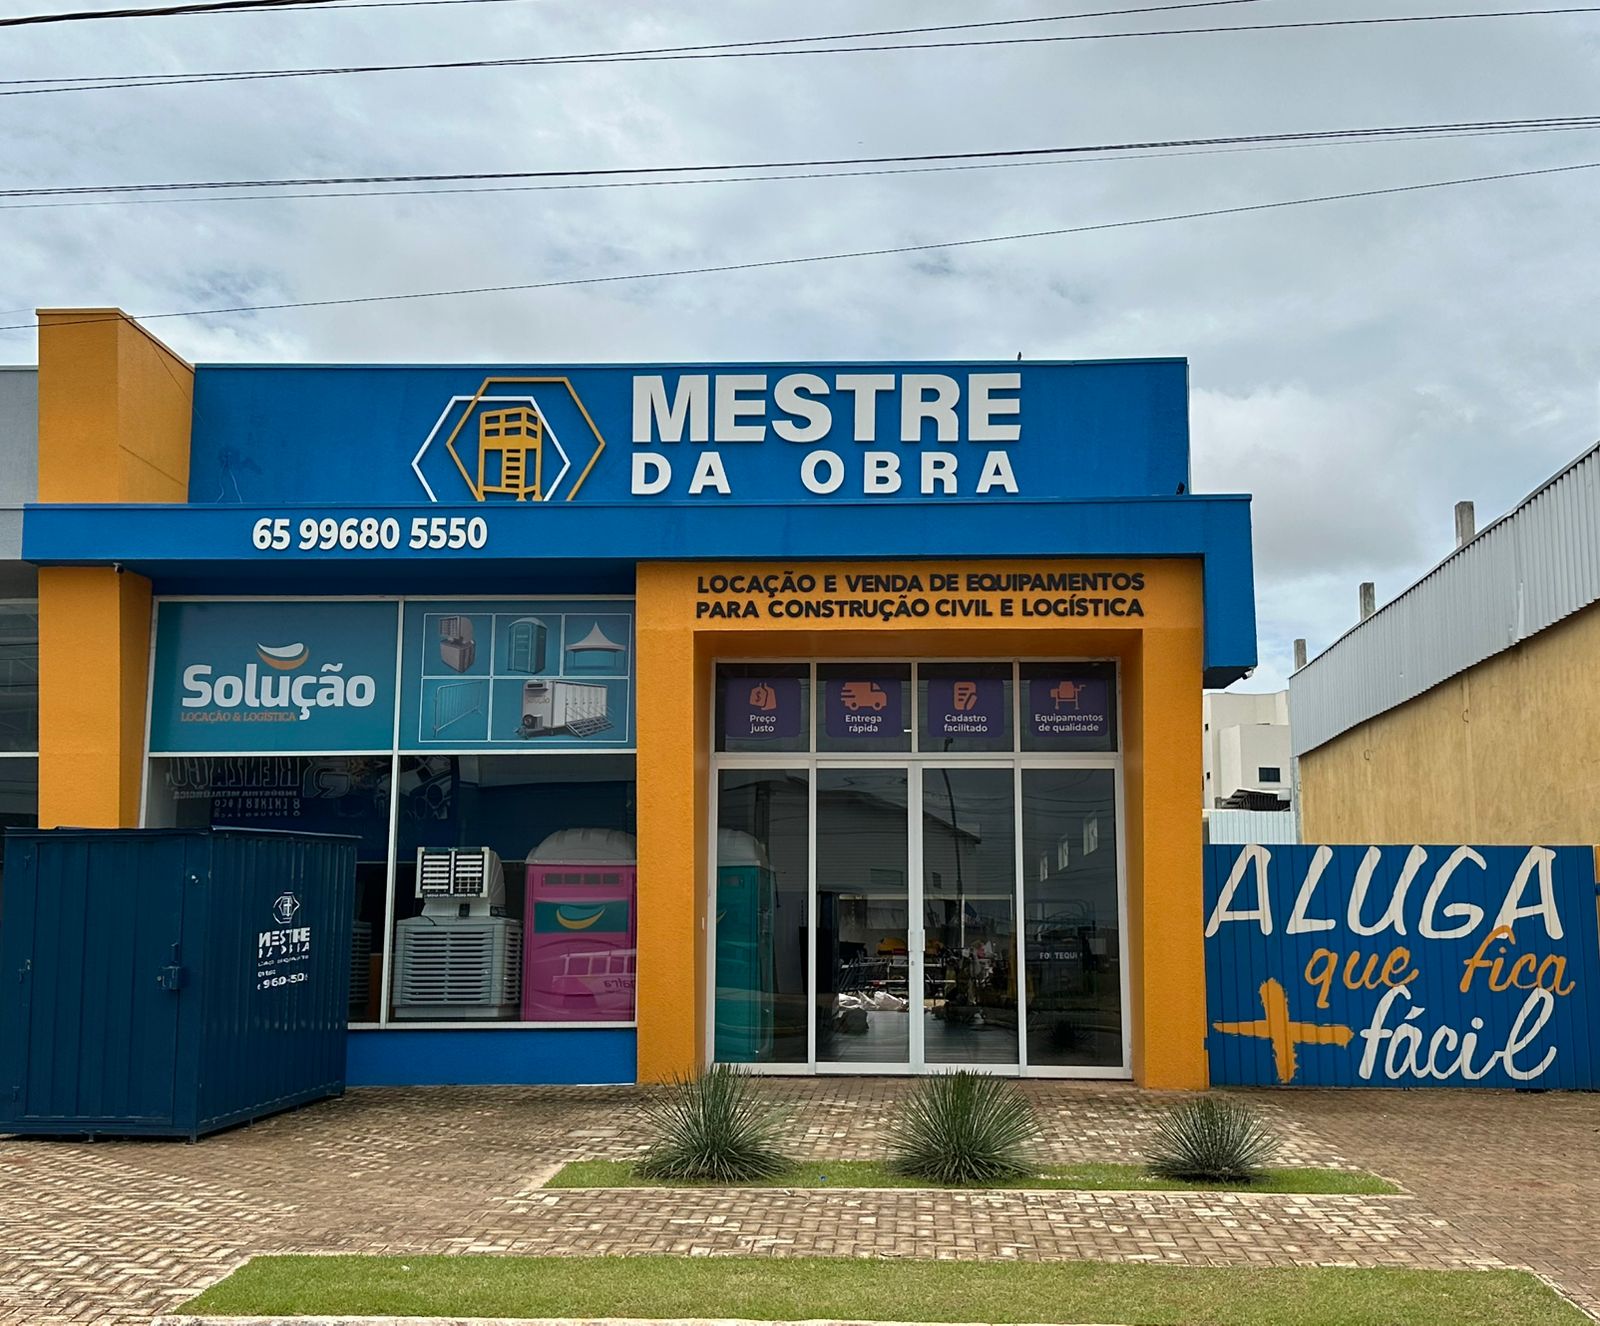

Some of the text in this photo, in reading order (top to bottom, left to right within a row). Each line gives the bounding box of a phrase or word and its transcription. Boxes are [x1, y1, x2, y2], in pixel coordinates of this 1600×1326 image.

[632, 373, 1022, 443] MESTRE
[631, 450, 1020, 495] DA OBRA
[252, 517, 488, 550] 65 99680 5550
[697, 570, 1145, 598] LOCAÇÃO E VENDA DE EQUIPAMENTOS
[696, 593, 1145, 621] PARA CONSTRUÇÃO CIVIL E LOGÍSTICA
[182, 663, 376, 721] Solução
[181, 710, 297, 724] LOCAÇÃO & LOGÍSTICA
[750, 714, 776, 725] Preço
[845, 714, 882, 724] Entrega
[944, 714, 987, 722] Cadastro
[944, 723, 988, 732] facilitado
[1035, 713, 1103, 723] Equipamentos
[750, 725, 775, 733] justo
[849, 724, 879, 733] rápida
[1038, 723, 1099, 733] de qualidade
[1205, 844, 1565, 940] ALUGA
[1304, 924, 1576, 1008] que fica
[1358, 984, 1557, 1081] fácil
